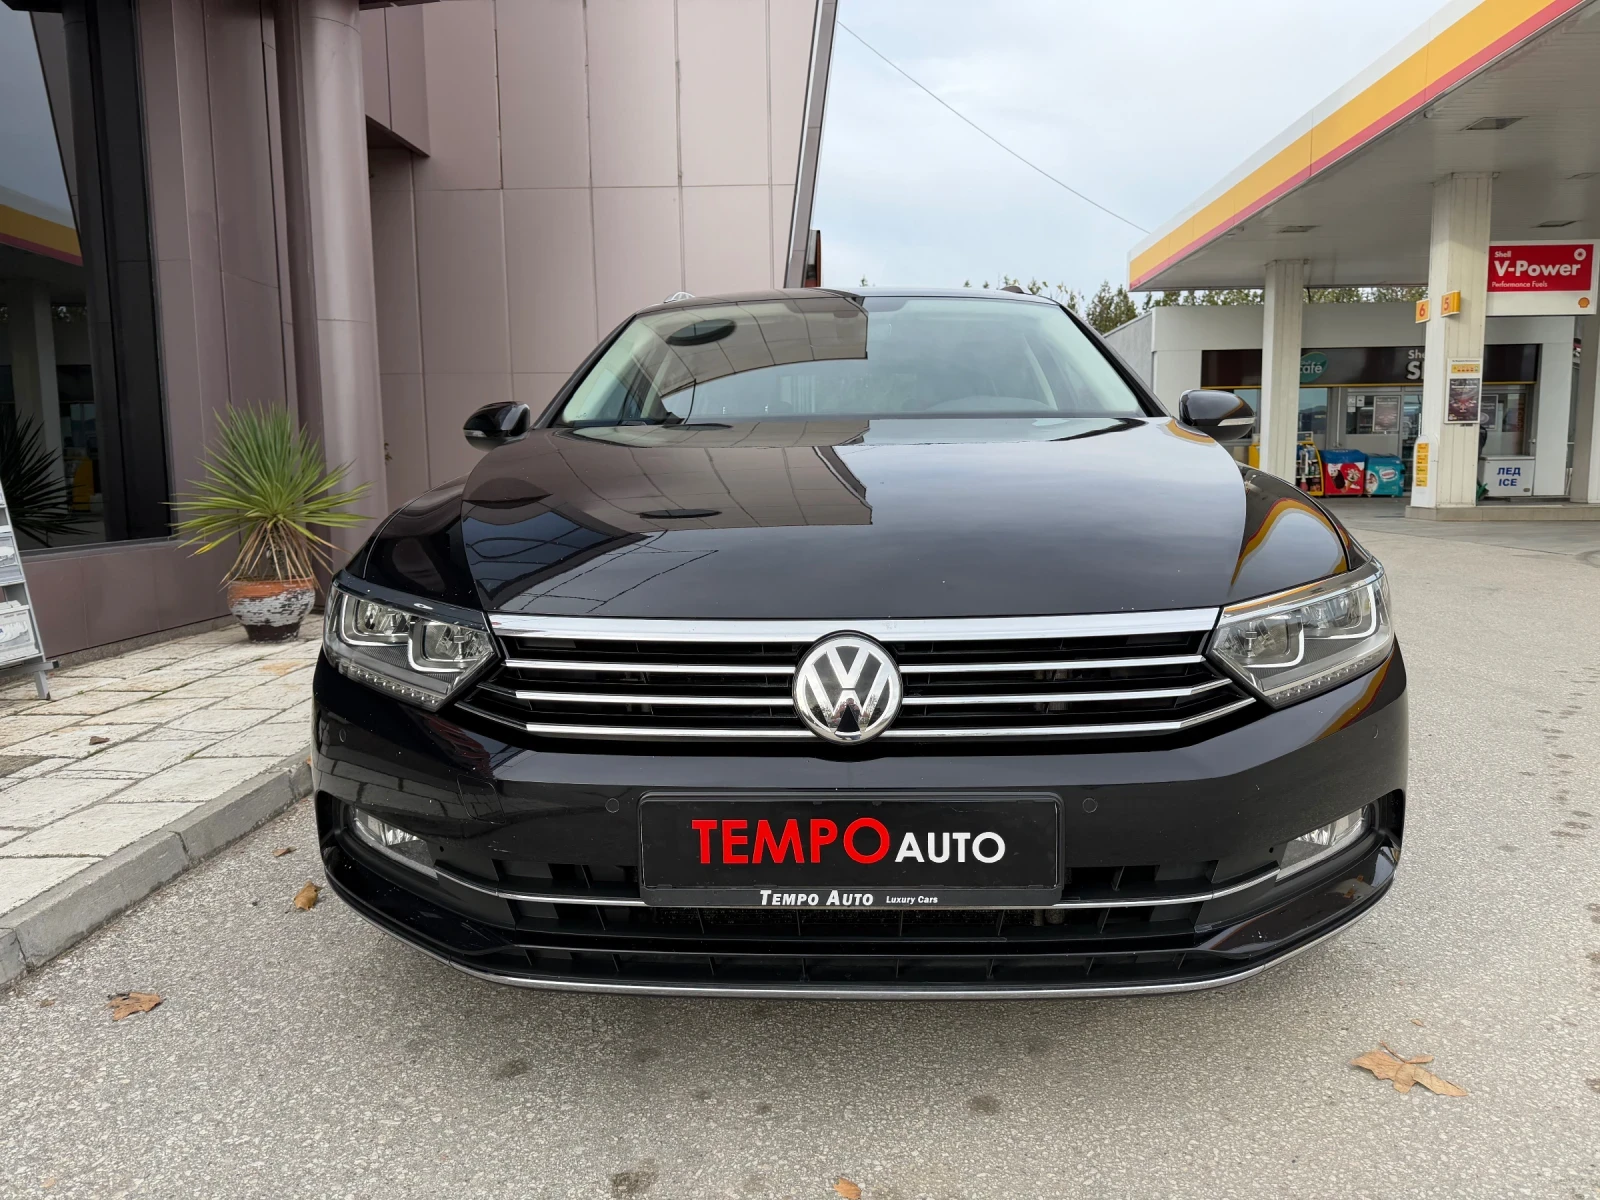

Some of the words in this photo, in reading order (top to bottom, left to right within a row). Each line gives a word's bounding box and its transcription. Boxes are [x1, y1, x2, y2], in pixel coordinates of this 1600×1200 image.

[1493, 260, 1581, 277] V-Power
[1531, 280, 1548, 288] Fuels
[1418, 303, 1426, 317] 6
[1443, 296, 1450, 311] 5
[1496, 467, 1521, 477] ЛЕД
[1498, 478, 1518, 487] ICE
[691, 817, 890, 865] TEMPO
[894, 831, 1006, 864] AUTO
[759, 889, 820, 906] TEMPO
[826, 889, 874, 906] AUTO
[885, 895, 915, 905] Luxury
[917, 895, 938, 904] Cars
